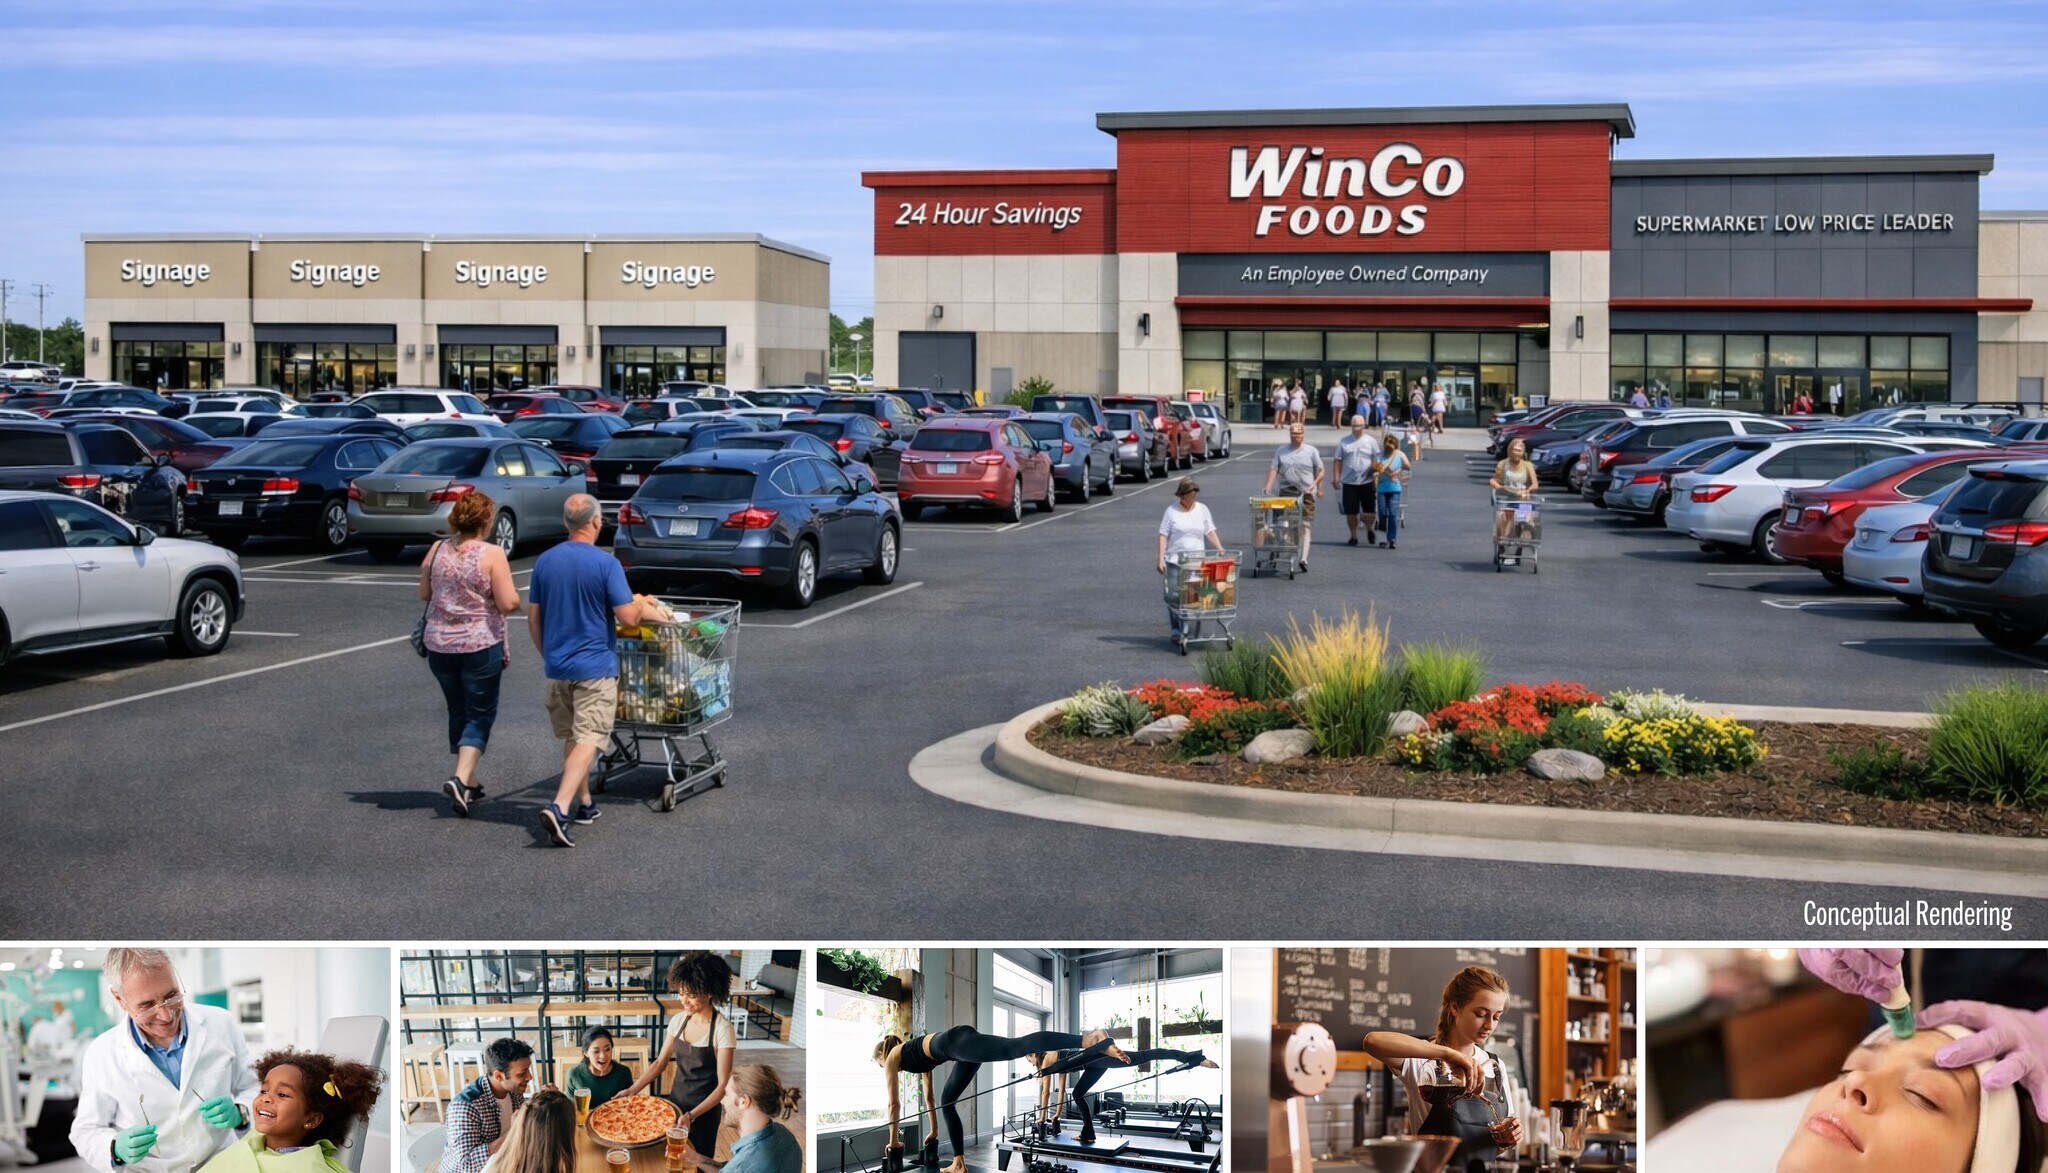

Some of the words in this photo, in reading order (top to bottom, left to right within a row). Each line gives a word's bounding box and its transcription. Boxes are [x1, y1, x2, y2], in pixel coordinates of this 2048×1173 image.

[1229, 142, 1466, 199] WinCo
[895, 202, 927, 225] 24
[933, 202, 989, 225] Hour
[992, 202, 1083, 230] Savings
[1255, 203, 1428, 238] FOODS
[1636, 215, 1768, 233] SUPERMARKET
[1774, 214, 1816, 232] LOW
[1822, 213, 1876, 231] PRICE
[1883, 213, 1955, 231] LEADER
[120, 258, 211, 287] Signage
[290, 258, 381, 287] Signage
[455, 259, 548, 288] Signage
[621, 260, 716, 288] Signage
[1241, 266, 1263, 281] An
[1268, 266, 1345, 285] Employee
[1350, 265, 1407, 281] Owned
[1412, 265, 1489, 284] Company
